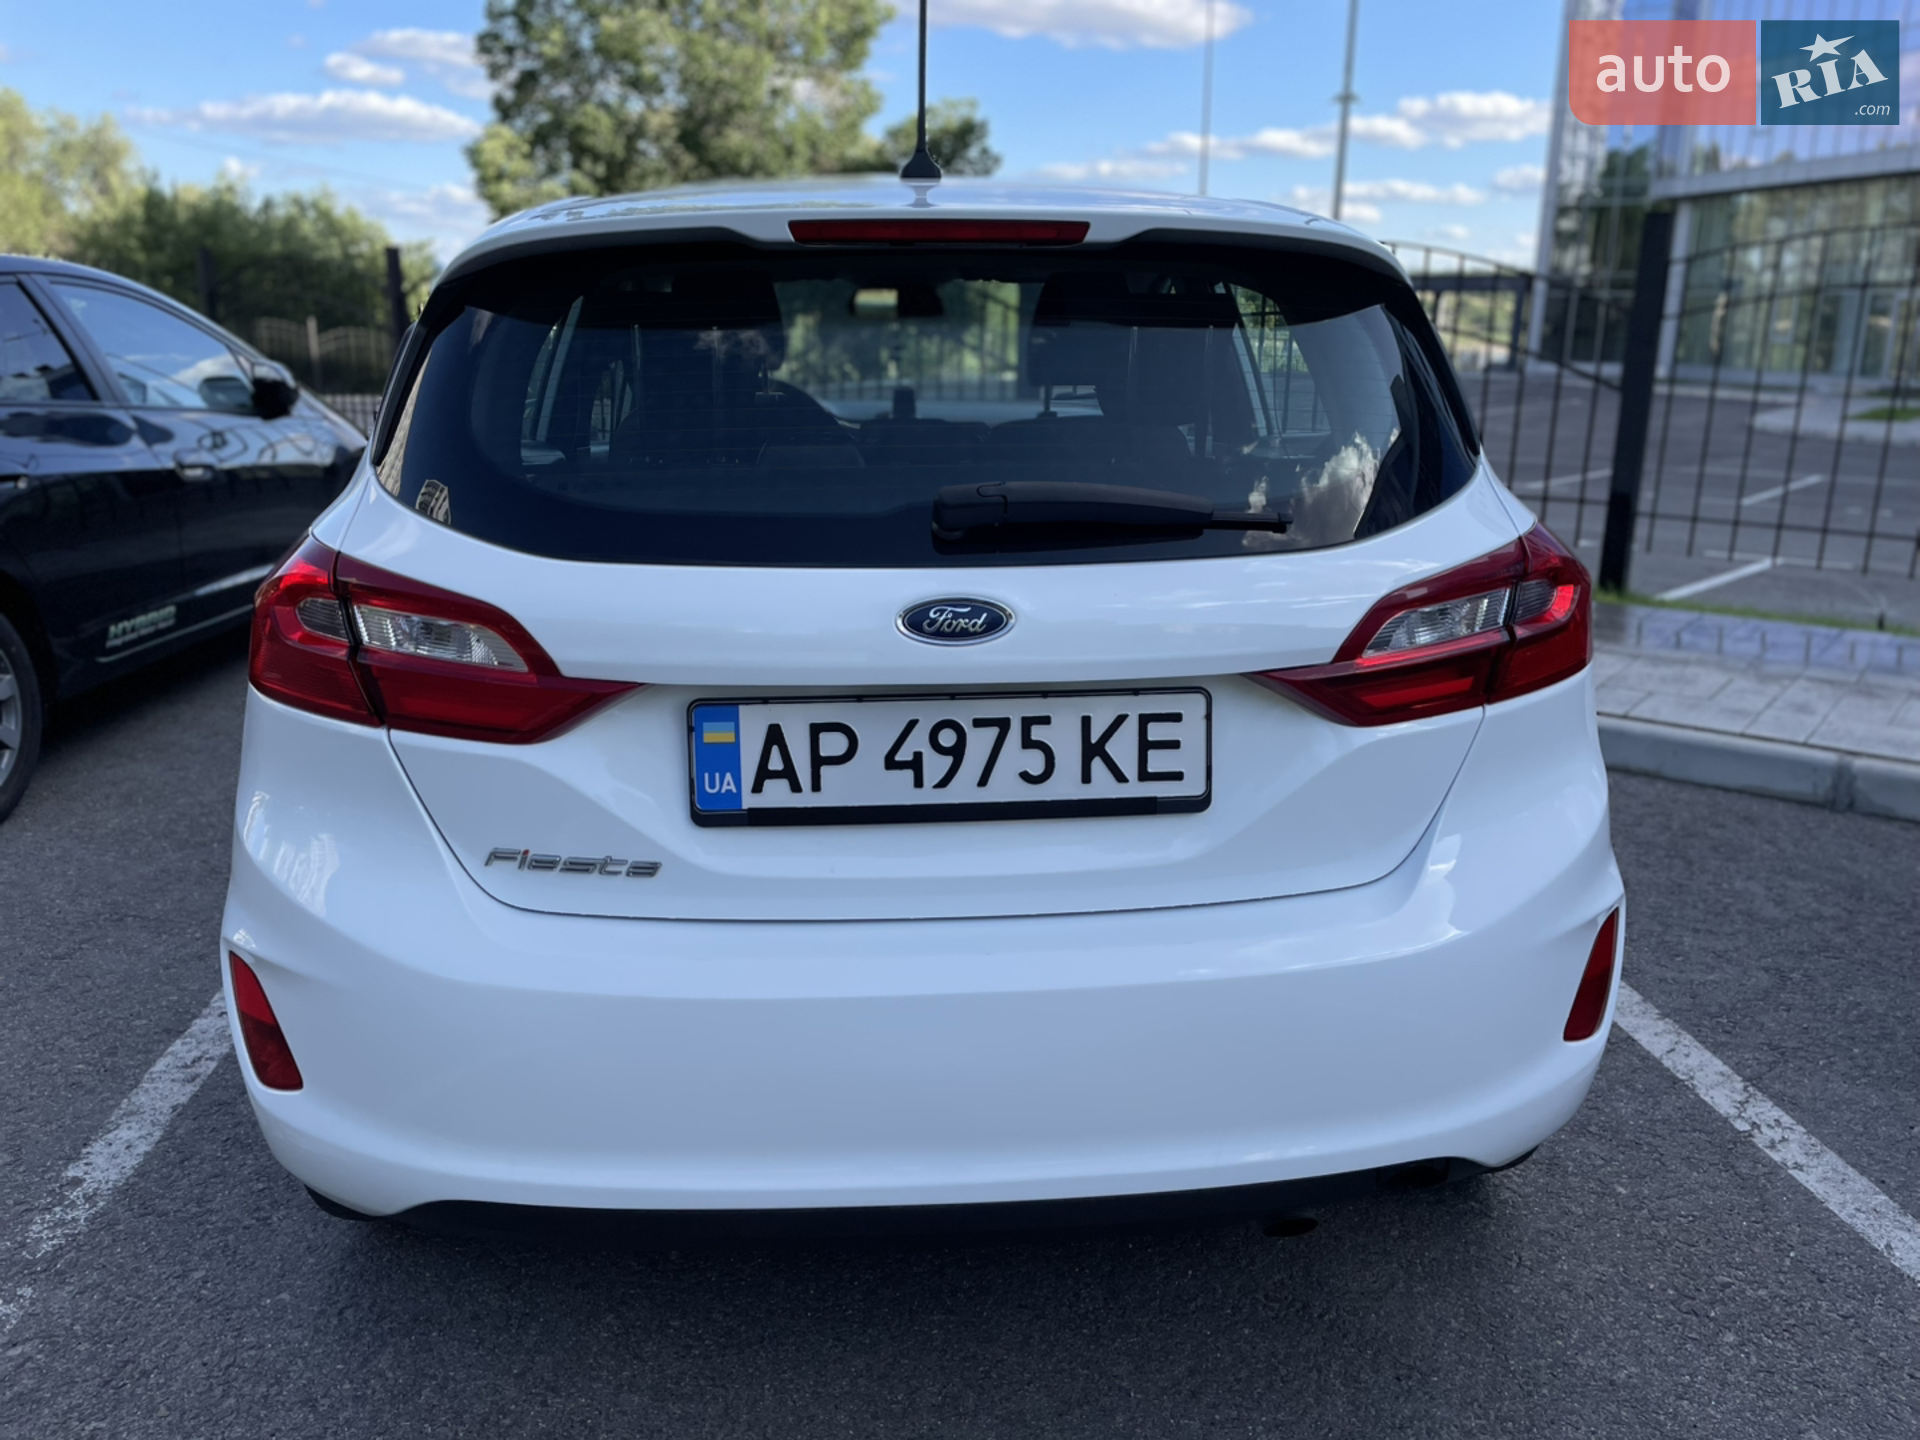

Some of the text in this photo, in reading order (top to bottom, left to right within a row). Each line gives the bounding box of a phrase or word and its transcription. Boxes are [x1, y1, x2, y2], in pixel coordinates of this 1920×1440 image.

[922, 605, 987, 633] Ford
[750, 711, 1185, 794] AP 4975 KE
[703, 772, 737, 795] UA
[484, 847, 663, 878] Fiesta
